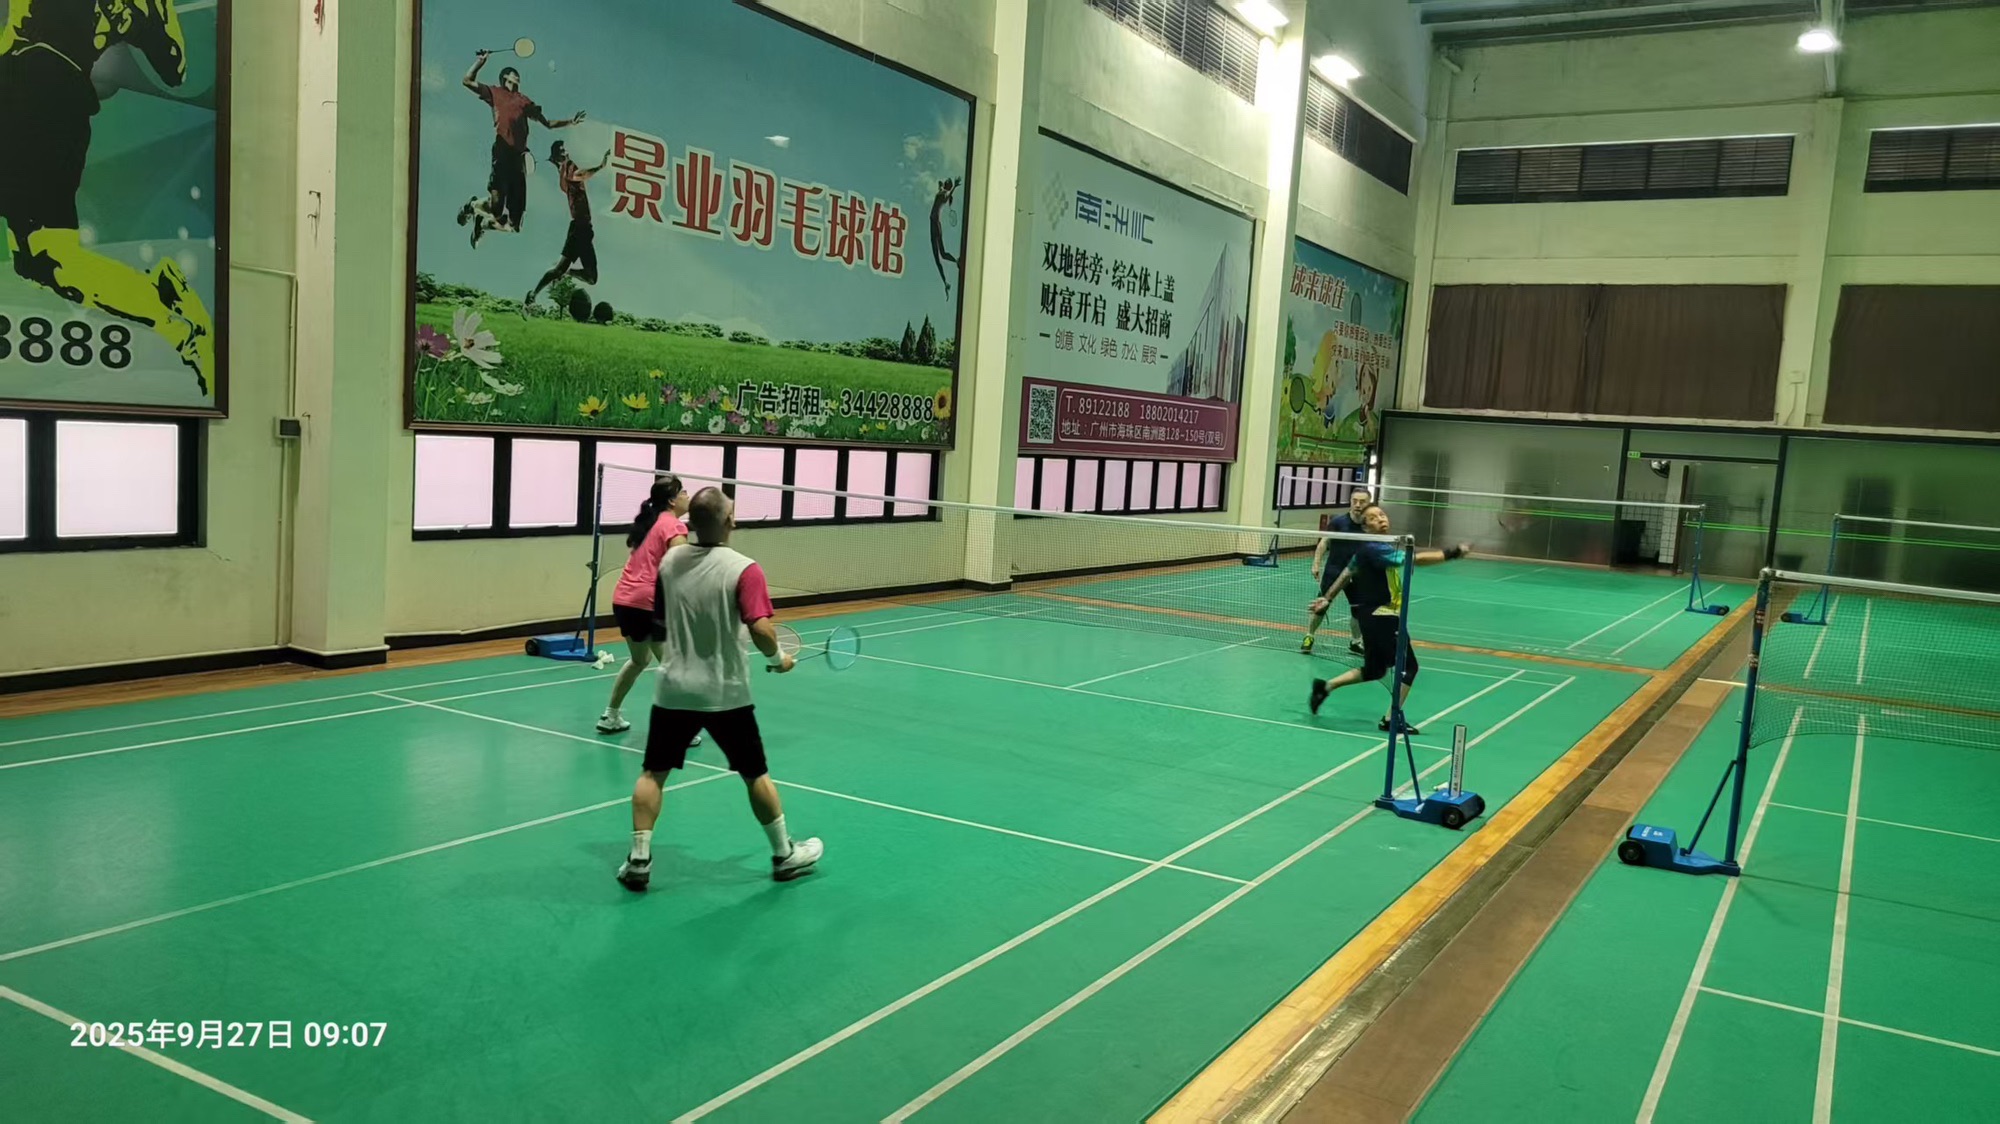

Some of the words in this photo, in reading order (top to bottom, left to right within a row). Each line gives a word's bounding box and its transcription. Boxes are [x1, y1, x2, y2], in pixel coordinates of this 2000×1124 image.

[610, 131, 907, 274] 景业羽毛球馆
[1040, 282, 1107, 326] 财富开启
[1116, 300, 1172, 340] 盛大招商
[1055, 328, 1074, 351] 创意
[1078, 333, 1096, 355] 文化
[1121, 341, 1138, 361] 办公
[840, 389, 934, 422] 34428888
[1139, 403, 1200, 424] 18802014217
